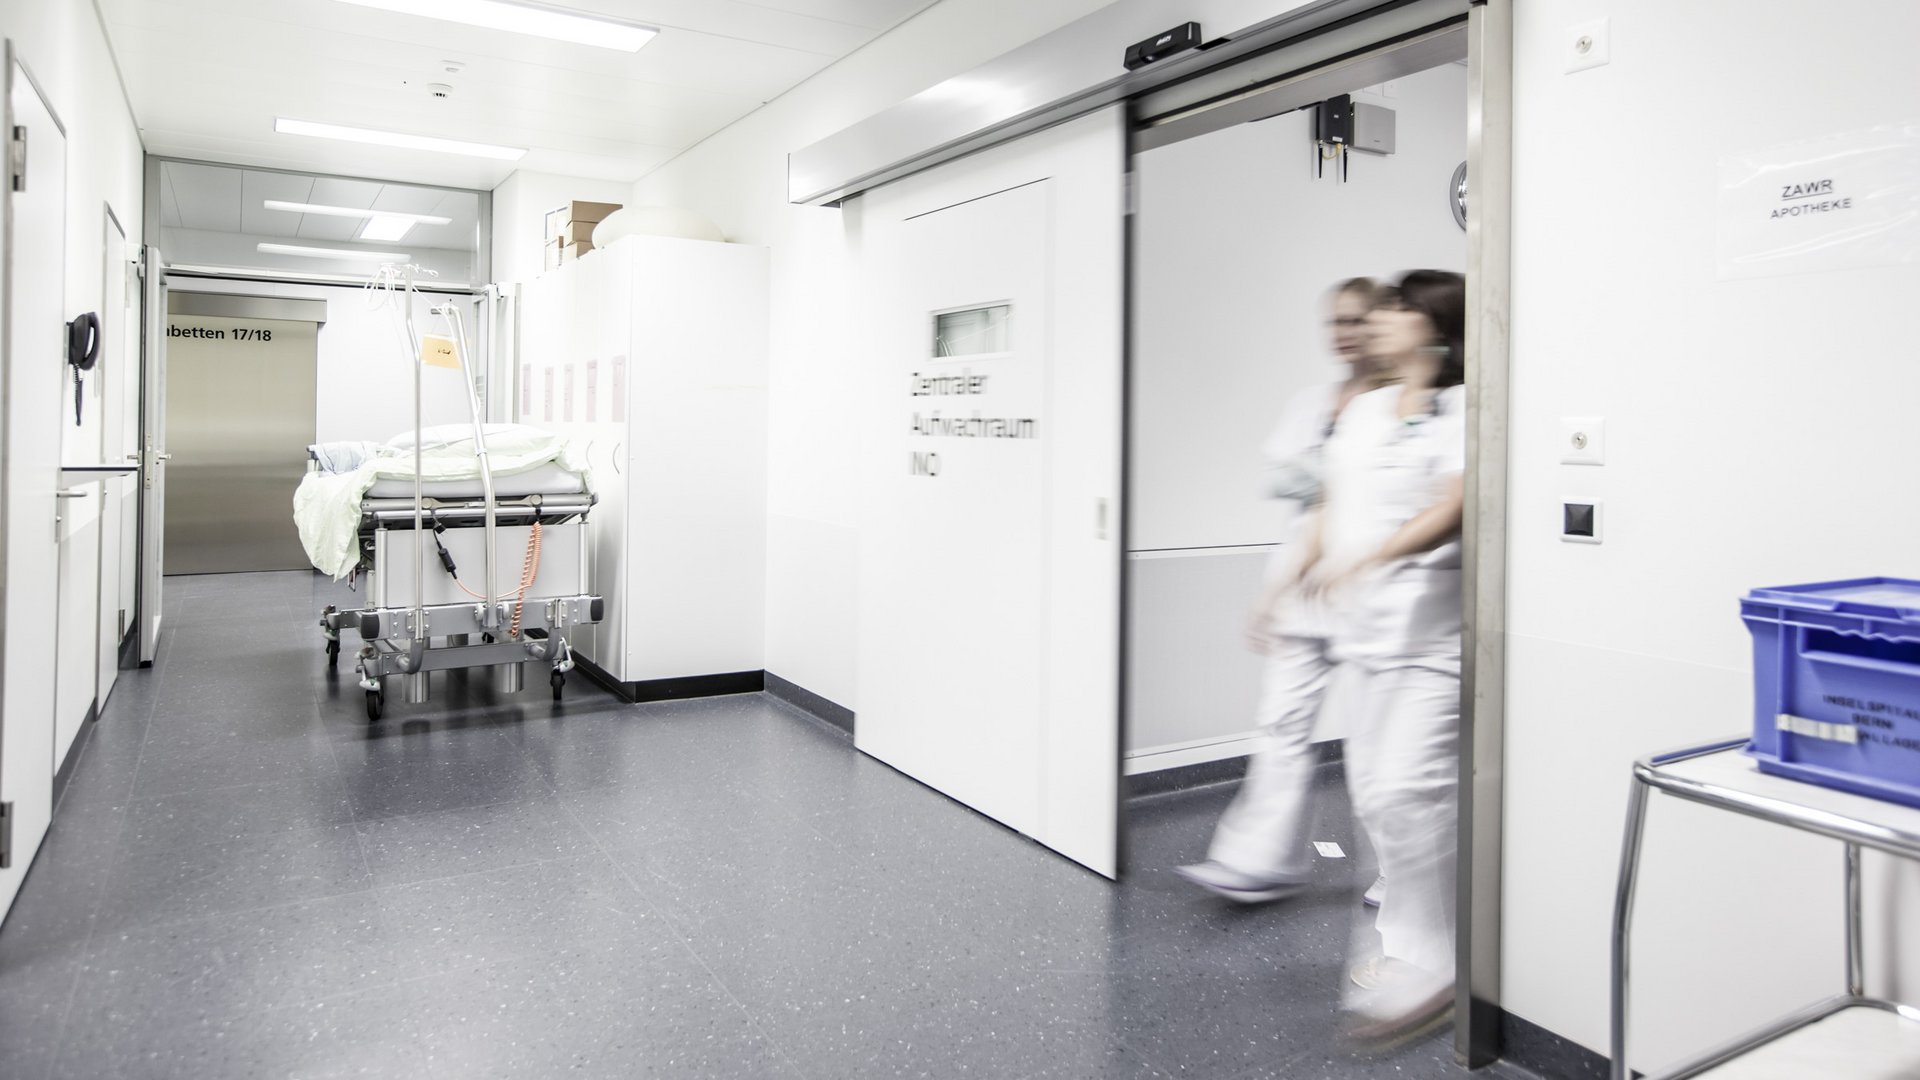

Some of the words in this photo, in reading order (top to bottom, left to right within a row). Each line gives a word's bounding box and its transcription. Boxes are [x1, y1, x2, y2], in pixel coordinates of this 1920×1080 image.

[1781, 179, 1834, 199] ZAWR
[1770, 197, 1852, 219] APOTHEKE
[167, 325, 225, 339] betten
[232, 329, 272, 341] 17/18
[1852, 712, 1894, 730] BERN
